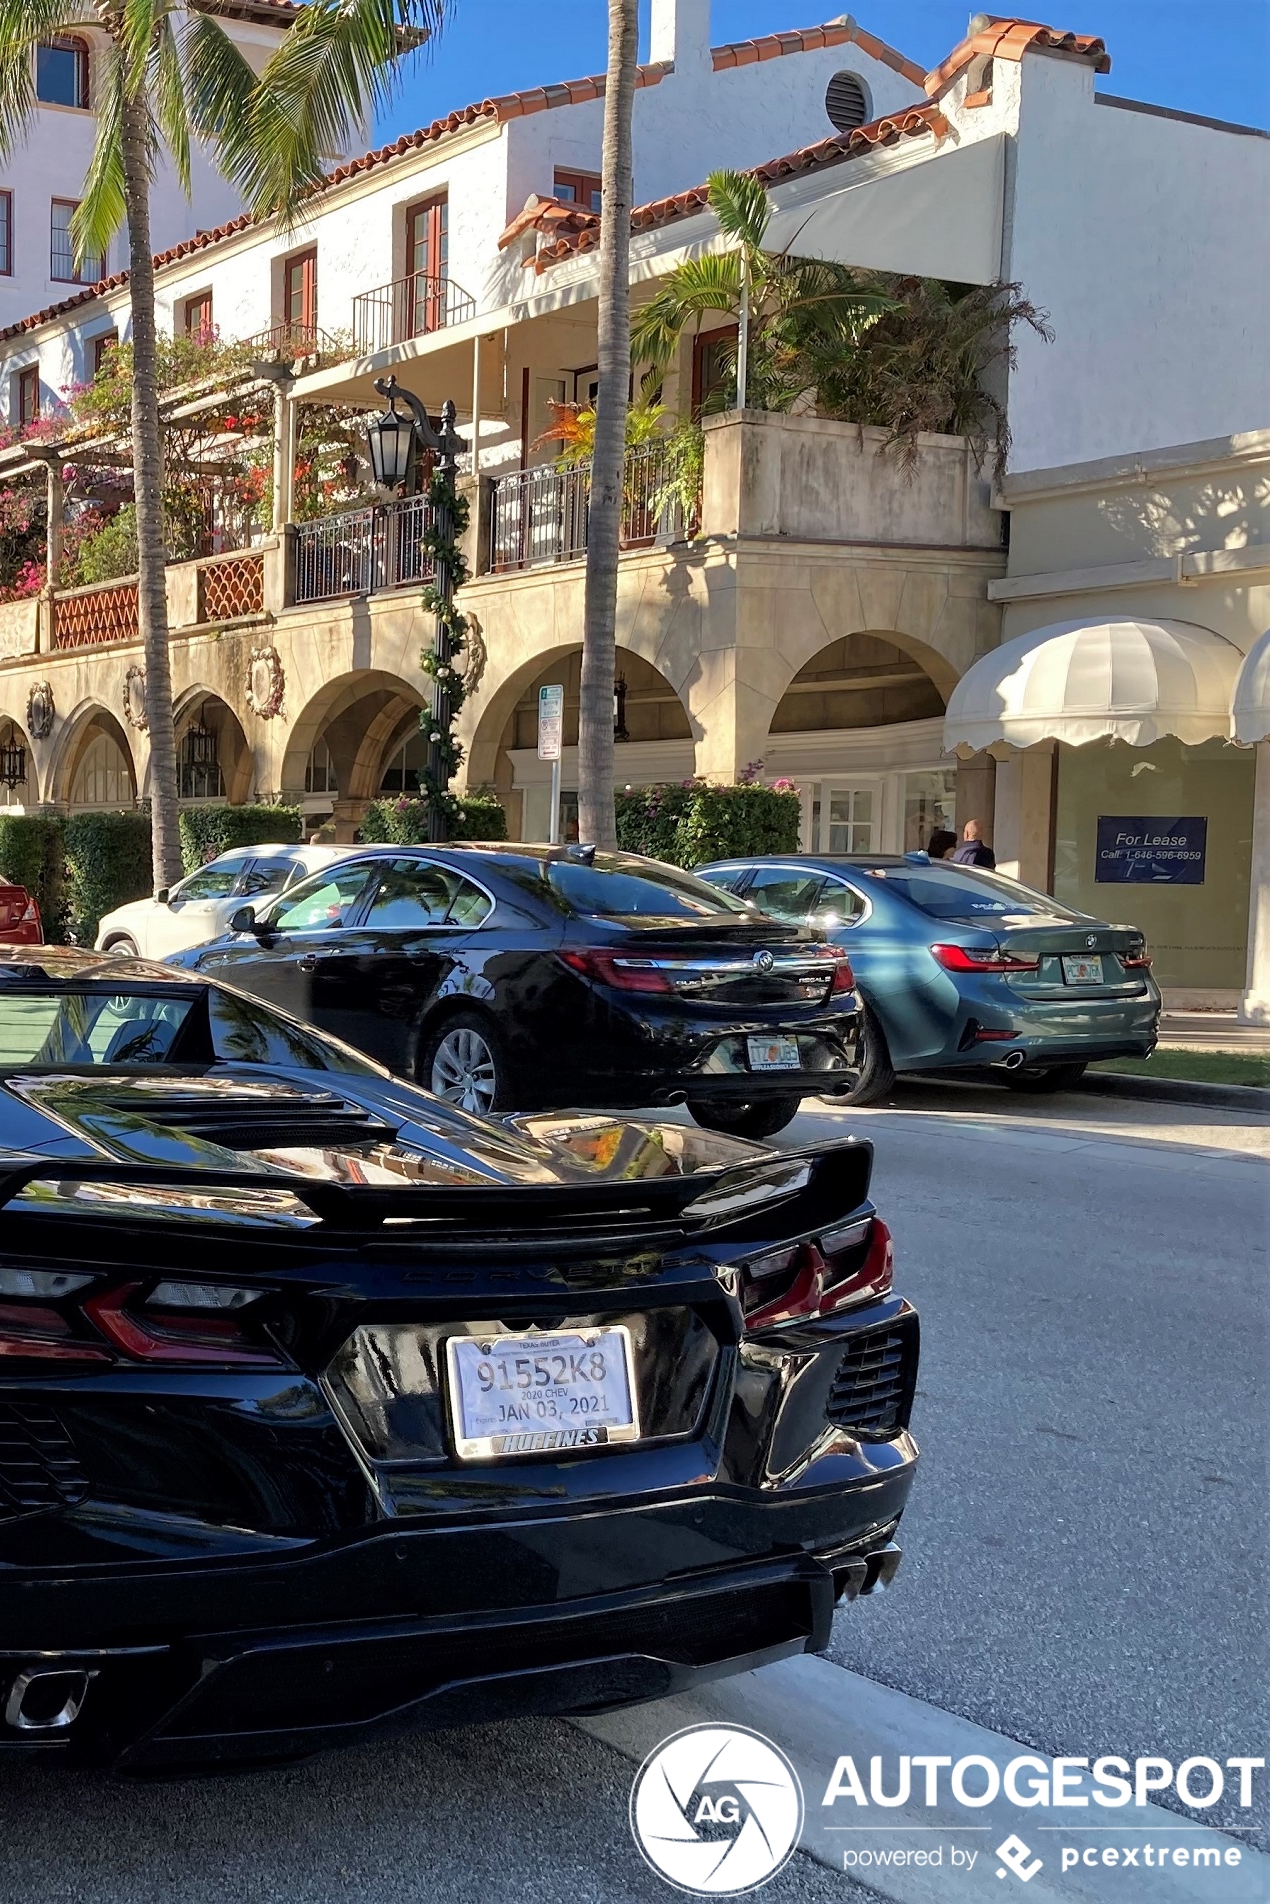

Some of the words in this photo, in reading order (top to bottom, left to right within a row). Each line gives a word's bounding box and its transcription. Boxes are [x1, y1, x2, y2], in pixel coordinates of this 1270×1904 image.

[1115, 833, 1141, 845] For
[1143, 833, 1187, 846] Lease
[1125, 850, 1202, 860] 1-646-596-6959
[403, 1256, 681, 1282] CORVETTE
[518, 1341, 539, 1349] TEXAS
[477, 1352, 607, 1393] 91552K8
[521, 1389, 543, 1401] 2020
[545, 1387, 569, 1398] CHEV
[498, 1403, 531, 1423] JAN
[536, 1399, 564, 1420] 03,
[569, 1395, 610, 1415] 2021
[501, 1428, 600, 1453] HUFFINES
